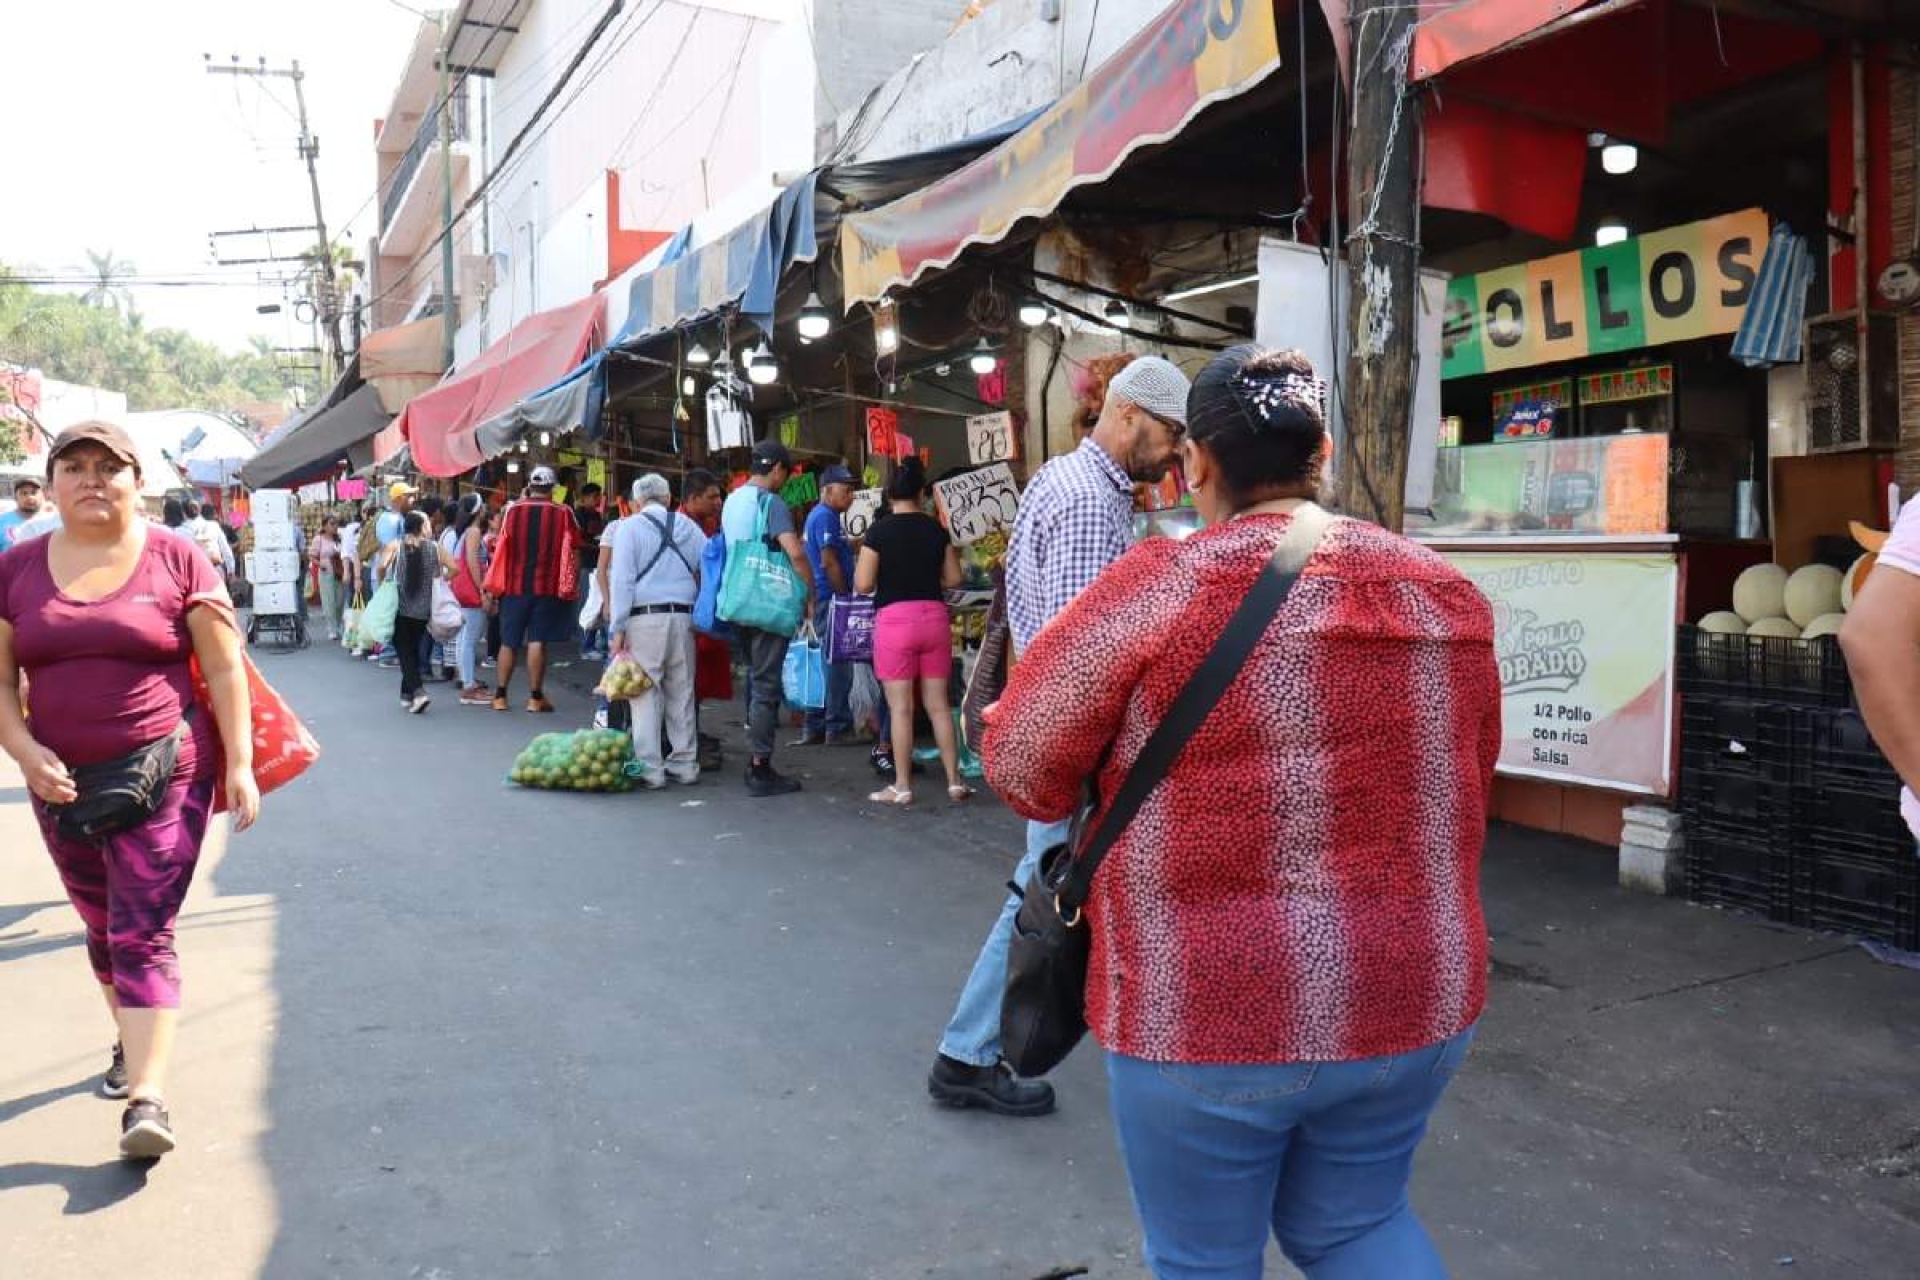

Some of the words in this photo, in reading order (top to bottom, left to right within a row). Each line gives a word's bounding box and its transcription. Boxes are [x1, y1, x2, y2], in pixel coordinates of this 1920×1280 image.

[1442, 236, 1756, 360] POLLOS
[1480, 559, 1585, 598] QUISITO
[1521, 619, 1585, 651] POLLO
[1499, 647, 1587, 687] OBADO
[1534, 703, 1553, 718] 1/2
[1558, 705, 1592, 722] Pollo
[1533, 728, 1558, 741] con
[1562, 728, 1588, 745] rica
[1533, 747, 1569, 766] Salsa
